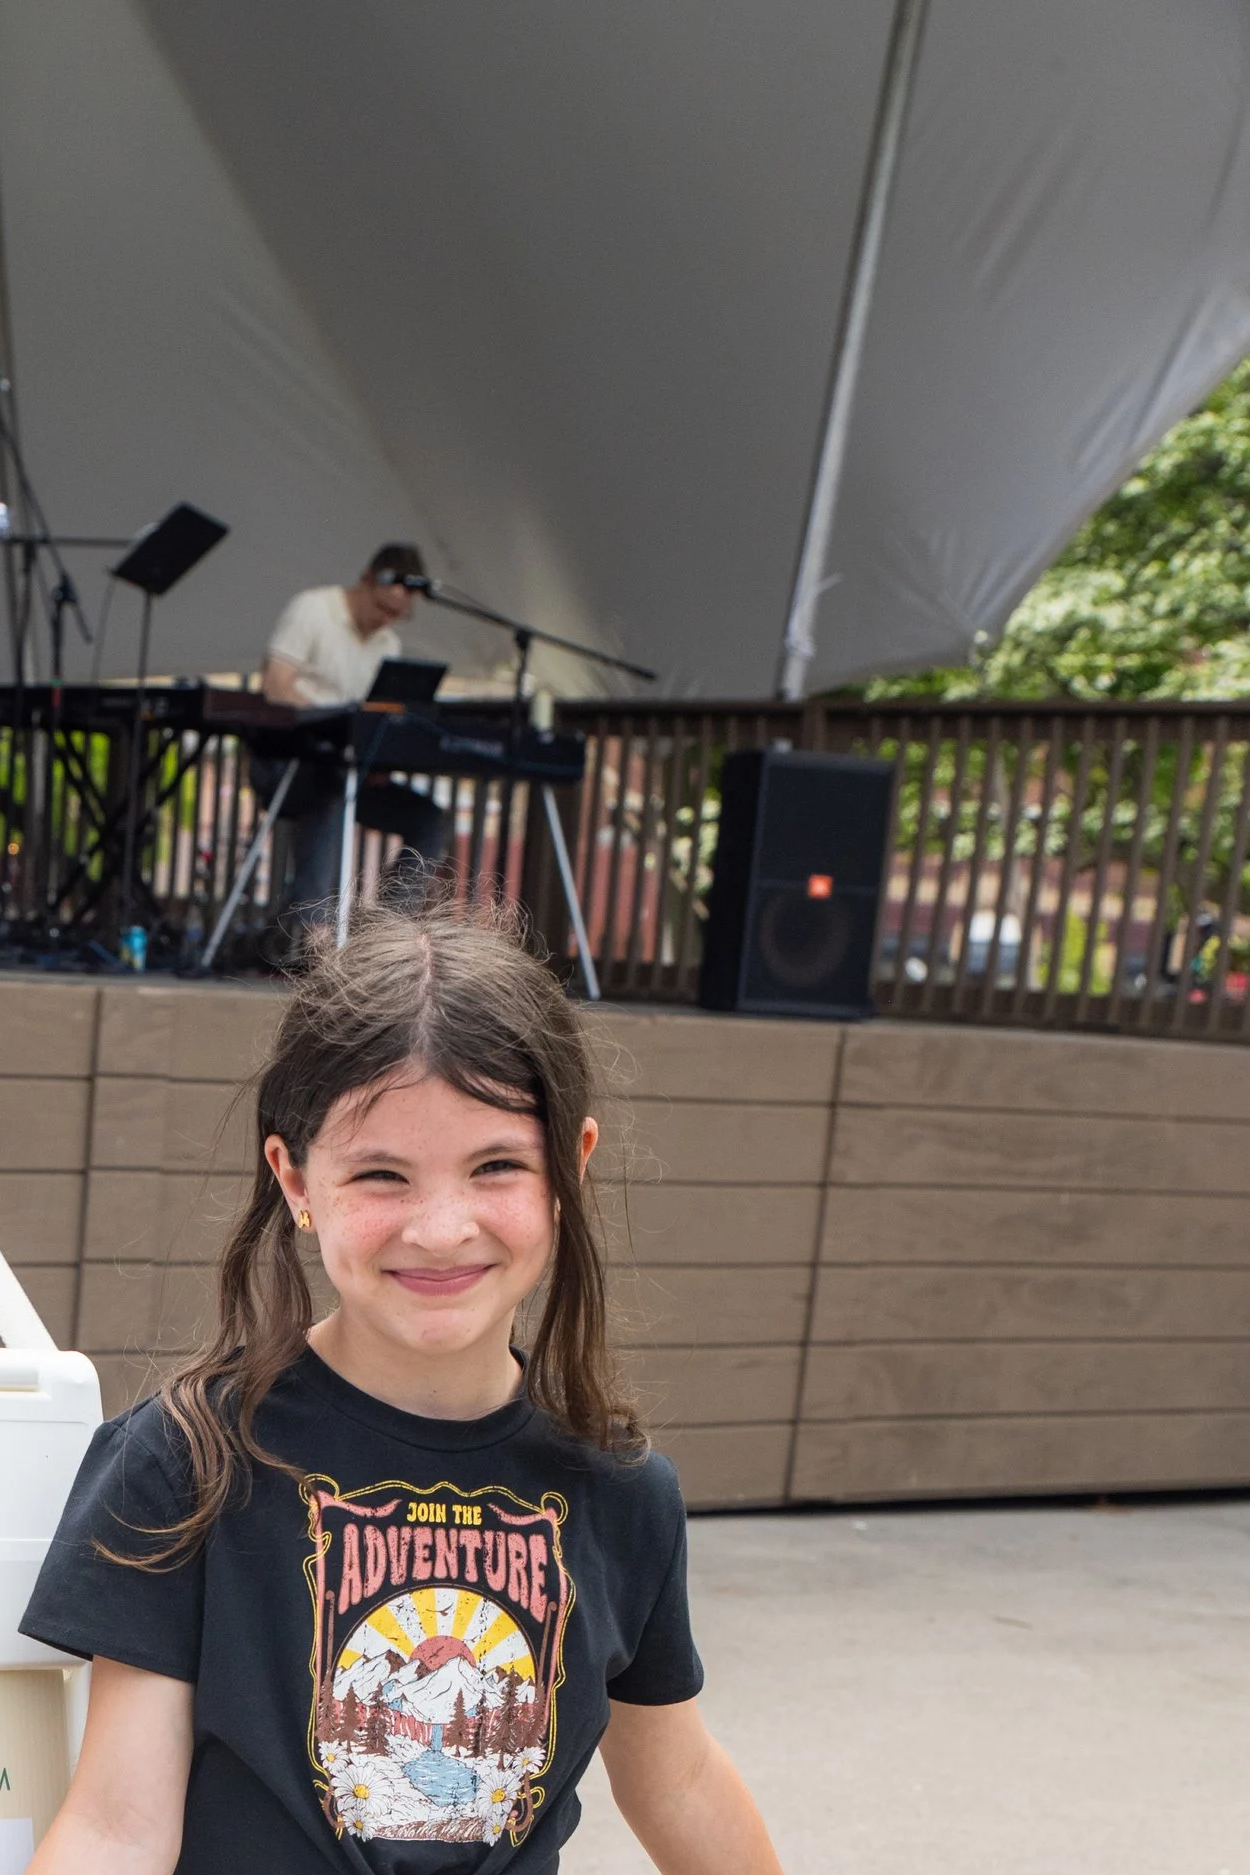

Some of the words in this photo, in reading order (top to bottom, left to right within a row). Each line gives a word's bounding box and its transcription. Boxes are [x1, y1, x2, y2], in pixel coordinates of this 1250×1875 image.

[406, 1502, 446, 1523] JOIN
[452, 1505, 482, 1525] THE
[338, 1523, 548, 1624] ADVENTURE
